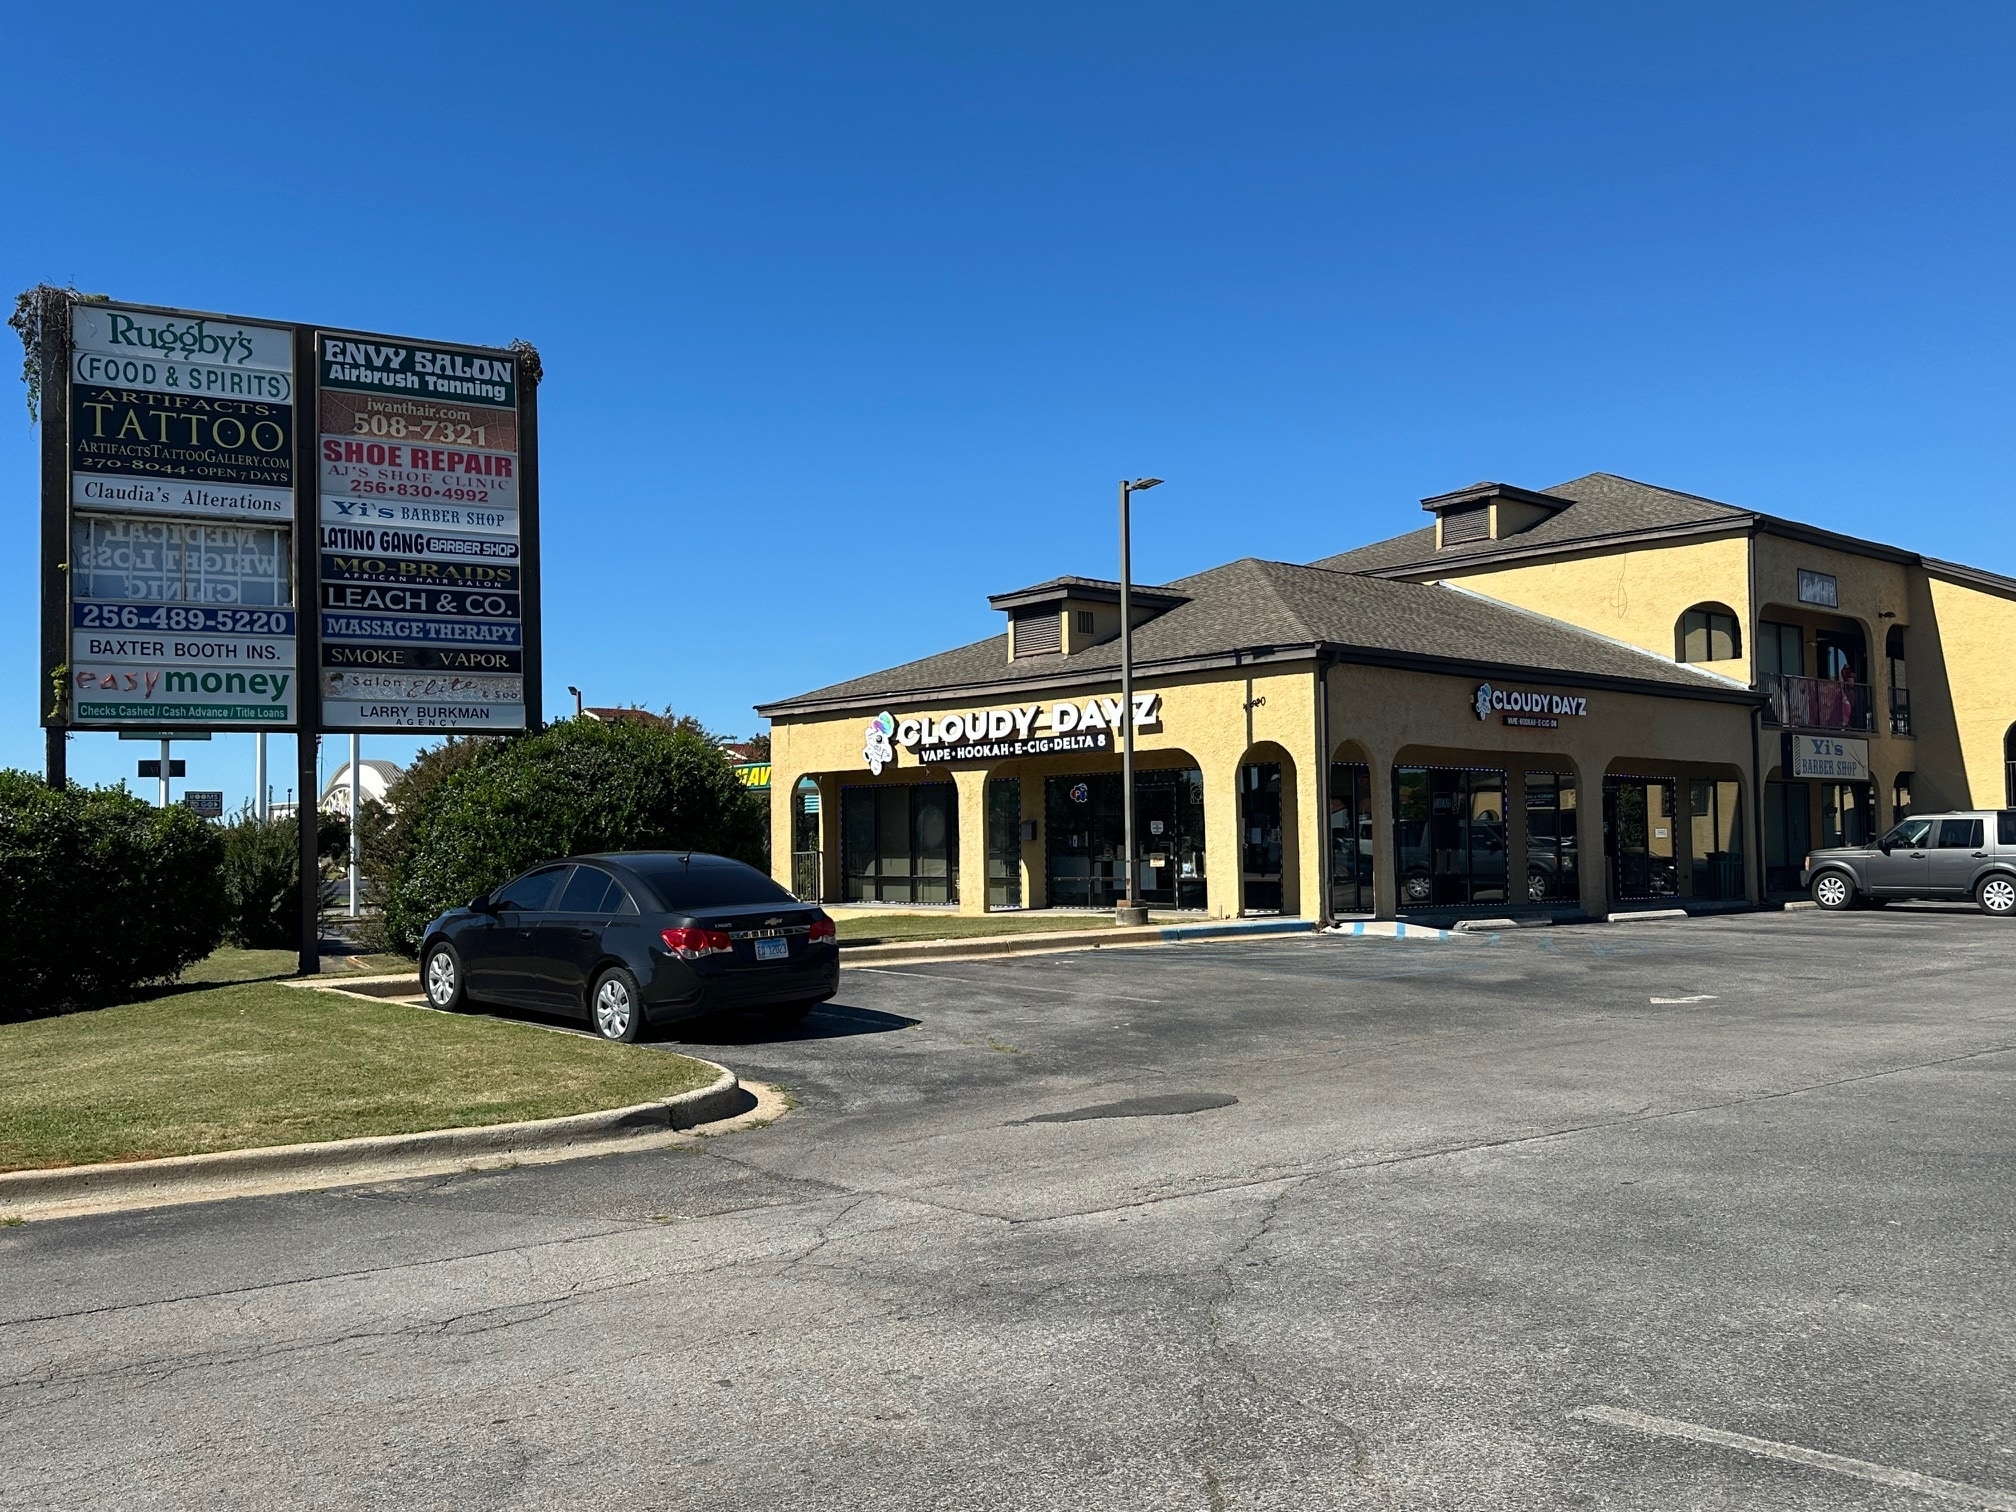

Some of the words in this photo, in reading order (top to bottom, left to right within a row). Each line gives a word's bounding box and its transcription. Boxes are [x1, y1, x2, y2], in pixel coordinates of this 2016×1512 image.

[107, 313, 253, 364] Ruggby's
[324, 340, 406, 369] ENVY
[414, 351, 511, 383] SALON
[165, 365, 179, 387] &
[329, 364, 419, 389] Airbrush
[425, 375, 506, 401] Tanning
[367, 397, 471, 421] iwanthair.com
[83, 401, 284, 452] TATTOO
[353, 412, 486, 446] 508-7321
[82, 457, 187, 475] 270-8044
[197, 466, 237, 478] OPEN
[240, 471, 246, 481] 7
[250, 470, 288, 482] DAYS
[323, 439, 402, 467] SHOE
[411, 448, 512, 477] REPAIR
[328, 464, 369, 478] AJ'S
[378, 469, 433, 483] SHOE
[442, 475, 510, 491] CLINIC
[84, 482, 170, 503] Claudia's
[181, 489, 281, 512] Alterations
[332, 500, 395, 519] Yi's
[401, 506, 460, 525] BARBER
[466, 512, 505, 527] SHOP
[321, 526, 375, 551] LATINO
[380, 529, 424, 554] GANG
[429, 539, 482, 555] BARBER
[482, 543, 516, 557] SHOP
[332, 557, 512, 582] MO-BRAIDS
[343, 573, 407, 582] AFRICAN
[416, 577, 449, 585] HAIR
[457, 579, 502, 588] SALON
[328, 587, 427, 611] LEACH
[436, 593, 458, 612] &
[465, 595, 512, 615] CO.
[83, 605, 287, 633] 256-489-5220
[327, 618, 424, 638] MASSAGE
[426, 622, 516, 642] THERAPY
[89, 639, 164, 657] BAXTER
[174, 642, 237, 659] BOOTH
[246, 644, 281, 661] INS.
[331, 648, 405, 664] SMOKE
[439, 652, 510, 668] VAPOR
[165, 671, 290, 702] money
[352, 676, 401, 688] Salon
[406, 677, 479, 699] Elite
[80, 705, 116, 716] Checks
[119, 705, 155, 717] Cashed
[162, 706, 187, 717] Cash
[188, 706, 228, 718] Advance
[236, 707, 256, 718] Title
[257, 707, 285, 719] Loans
[360, 706, 410, 718] LARRY
[416, 707, 490, 719] BURKMAN
[1492, 690, 1551, 713] CLOUDY
[1552, 696, 1587, 716] DAYZ
[395, 718, 457, 727] AGENCY
[897, 705, 1041, 747] CLOUDY
[1051, 694, 1160, 733] DAYZ
[922, 749, 951, 762] VAPE
[956, 743, 1010, 759] HOOKAH
[1053, 735, 1095, 751] DELTA
[1097, 734, 1107, 747] 8
[1811, 739, 1844, 756] Yi's
[1802, 758, 1835, 775] BARBER
[1837, 760, 1857, 777] SHOP
